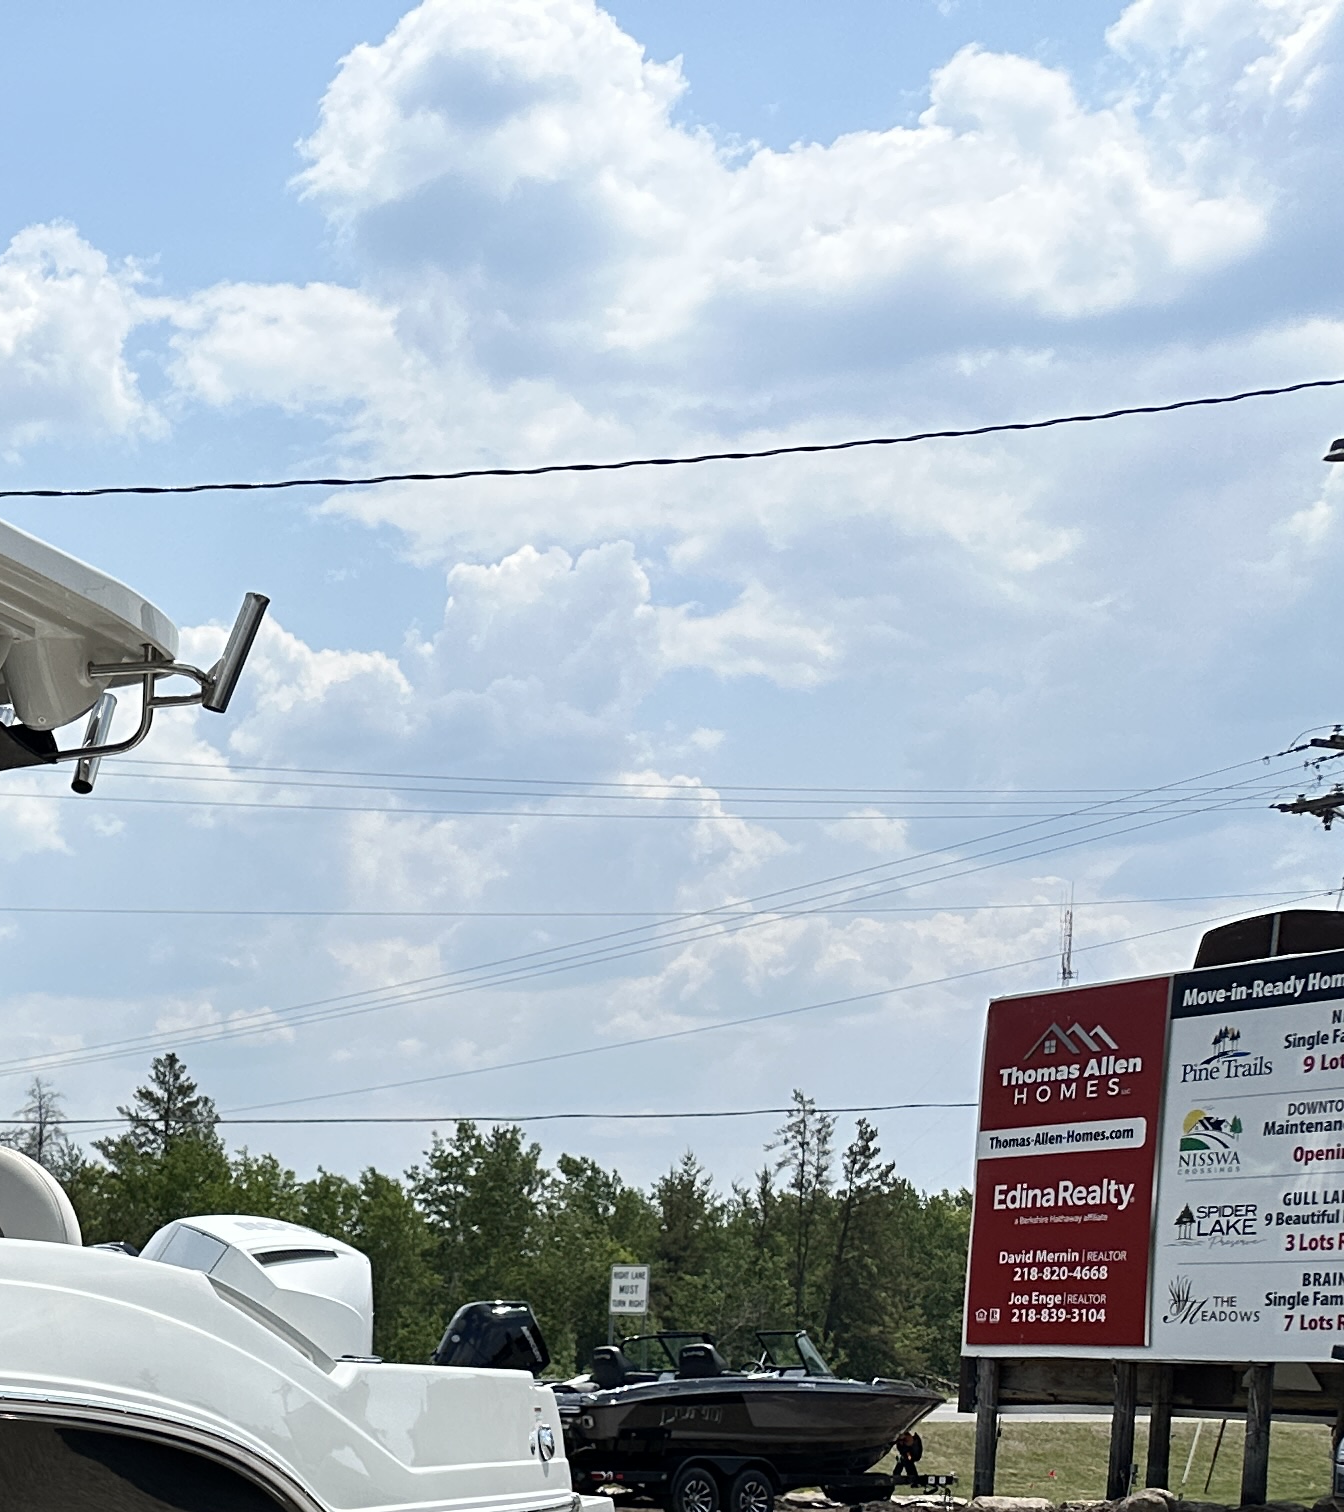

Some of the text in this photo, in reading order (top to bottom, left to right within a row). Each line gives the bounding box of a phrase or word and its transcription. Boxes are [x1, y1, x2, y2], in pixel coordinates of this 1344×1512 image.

[1182, 975, 1306, 1007] Move-in-Ready
[1284, 1031, 1330, 1050] Single
[999, 1056, 1142, 1086] Thomas Allen
[1180, 1056, 1273, 1084] Pine Trails
[1303, 1056, 1316, 1074] 9
[1014, 1078, 1120, 1105] HOMES
[1263, 1119, 1344, 1136] Maintenan
[989, 1127, 1134, 1150] Thomas-Allen-Homes.com
[1178, 1151, 1241, 1168] NISSWA
[1293, 1143, 1344, 1166] Openi
[993, 1178, 1134, 1211] Edina Realty
[1283, 1191, 1318, 1206] GULL
[1196, 1204, 1257, 1219] SPIDER
[1264, 1213, 1273, 1226] 9
[1276, 1209, 1340, 1226] Beautiful
[1196, 1218, 1257, 1237] LAKE
[1285, 1234, 1295, 1251] 3
[1299, 1233, 1334, 1251] Lots
[999, 1249, 1127, 1264] David Mernin REALTOR
[1013, 1265, 1108, 1281] 218-820-4668
[619, 1285, 639, 1294] MUST
[1008, 1292, 1107, 1307] Joe Enge REALTOR
[1213, 1296, 1237, 1307] THE
[1264, 1291, 1309, 1310] Single
[1011, 1308, 1106, 1322] 218-839-3104
[1284, 1315, 1294, 1331] 7
[1300, 1314, 1333, 1330] Lots
